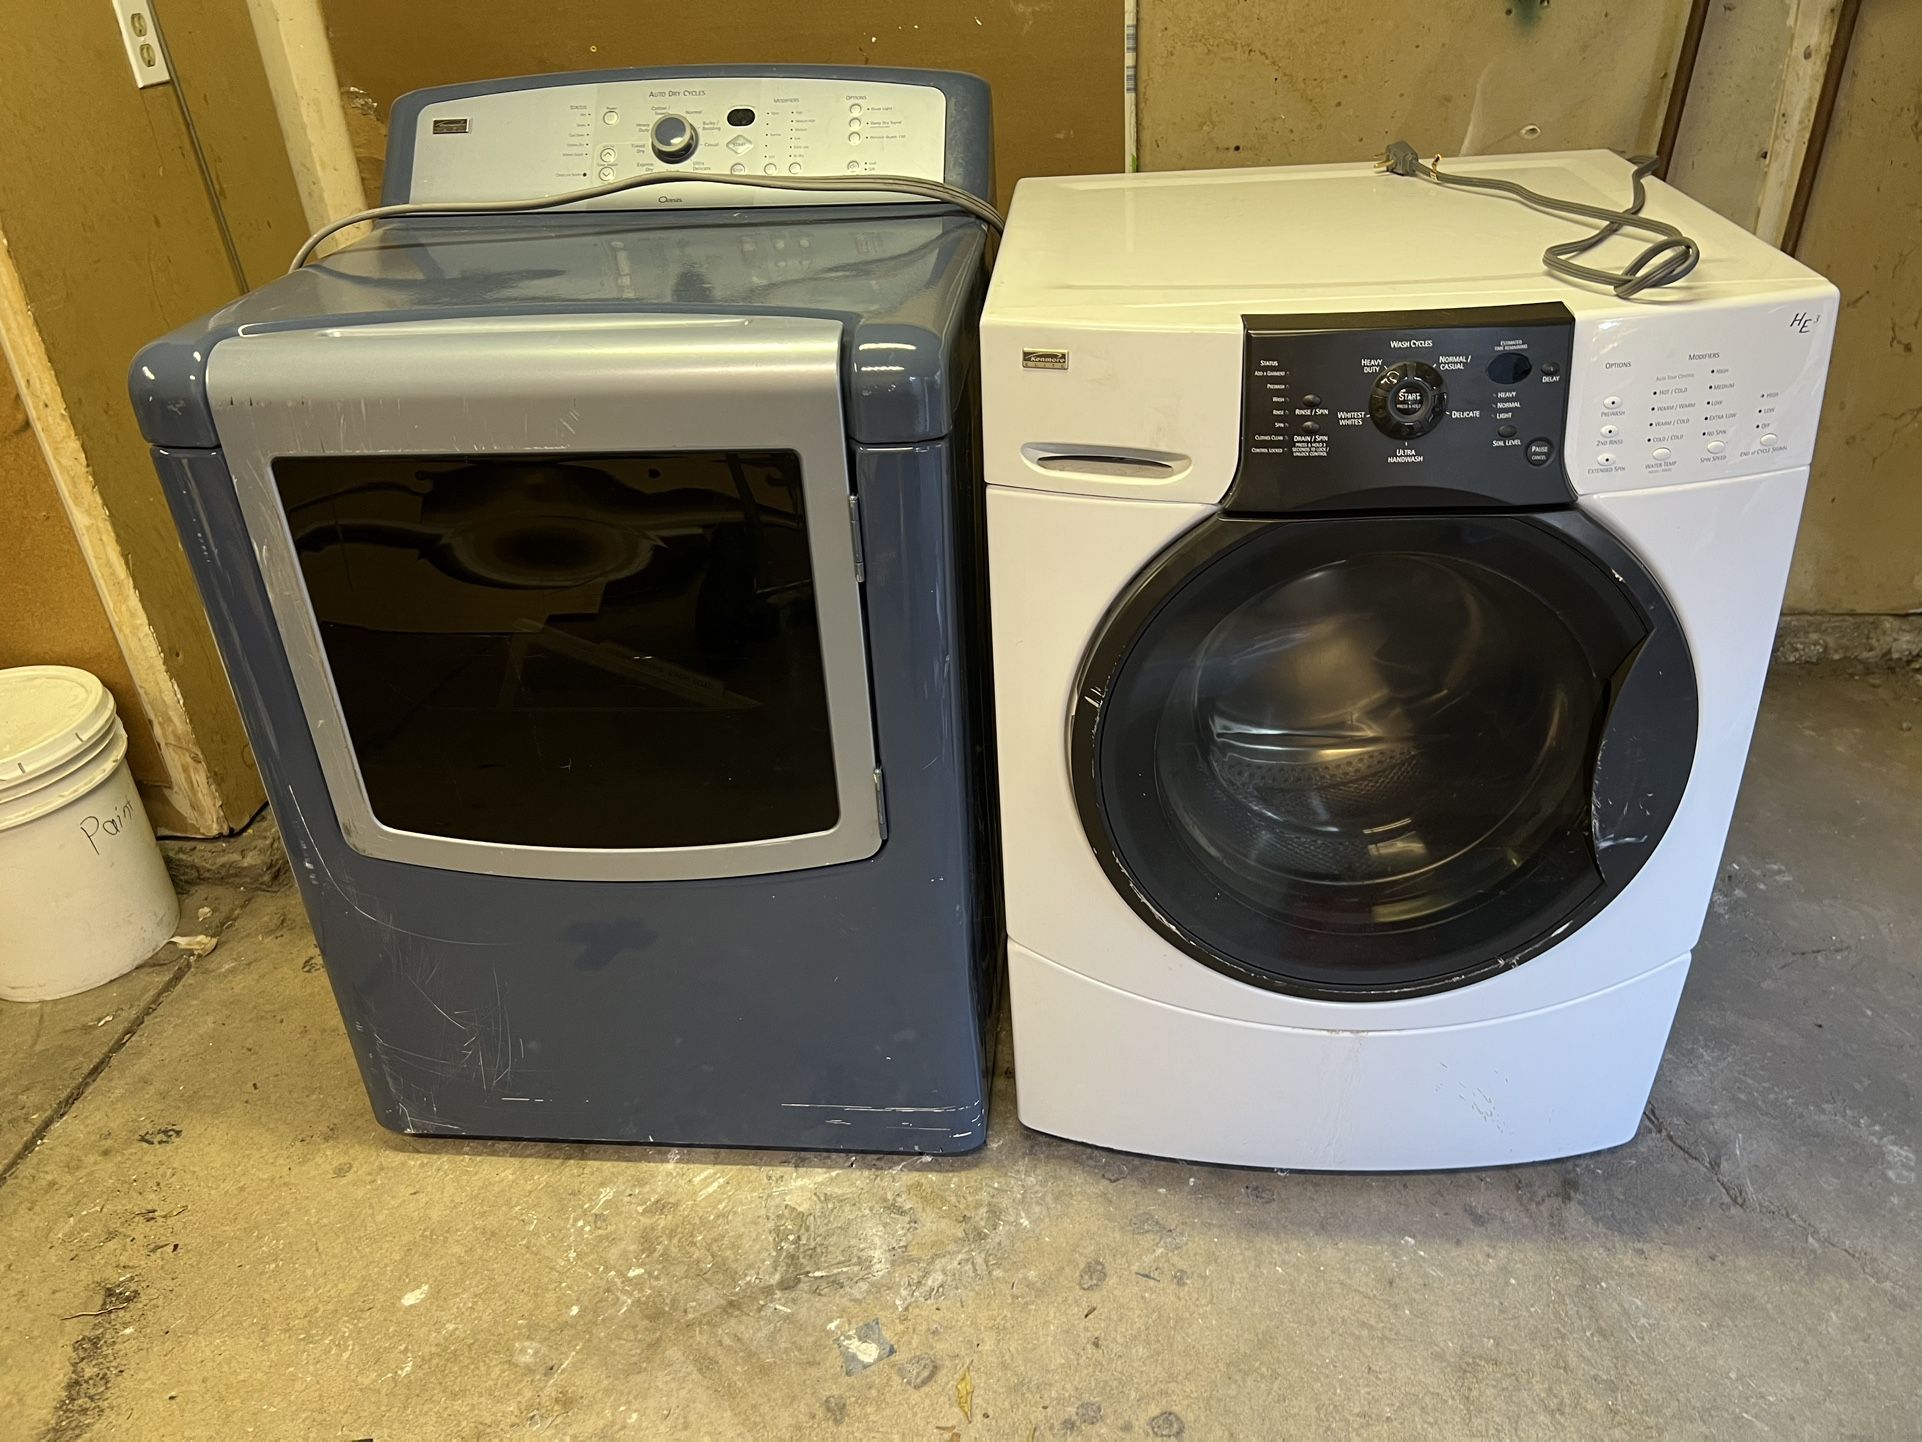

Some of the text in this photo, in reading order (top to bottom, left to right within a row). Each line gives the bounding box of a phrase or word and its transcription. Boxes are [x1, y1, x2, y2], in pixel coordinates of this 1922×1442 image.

[648, 89, 706, 98] AUTO DRY CYCLES
[1390, 340, 1433, 348] WASH CYCLES
[1439, 356, 1466, 364] NORMAL
[1688, 352, 1720, 361] MODIFIERS
[1605, 361, 1632, 370] OPTIONS
[1542, 375, 1560, 383] DELAY
[1398, 390, 1421, 401] START
[1452, 410, 1480, 418] DELICATE
[1645, 462, 1663, 470] WATER
[80, 796, 134, 856] Paint
